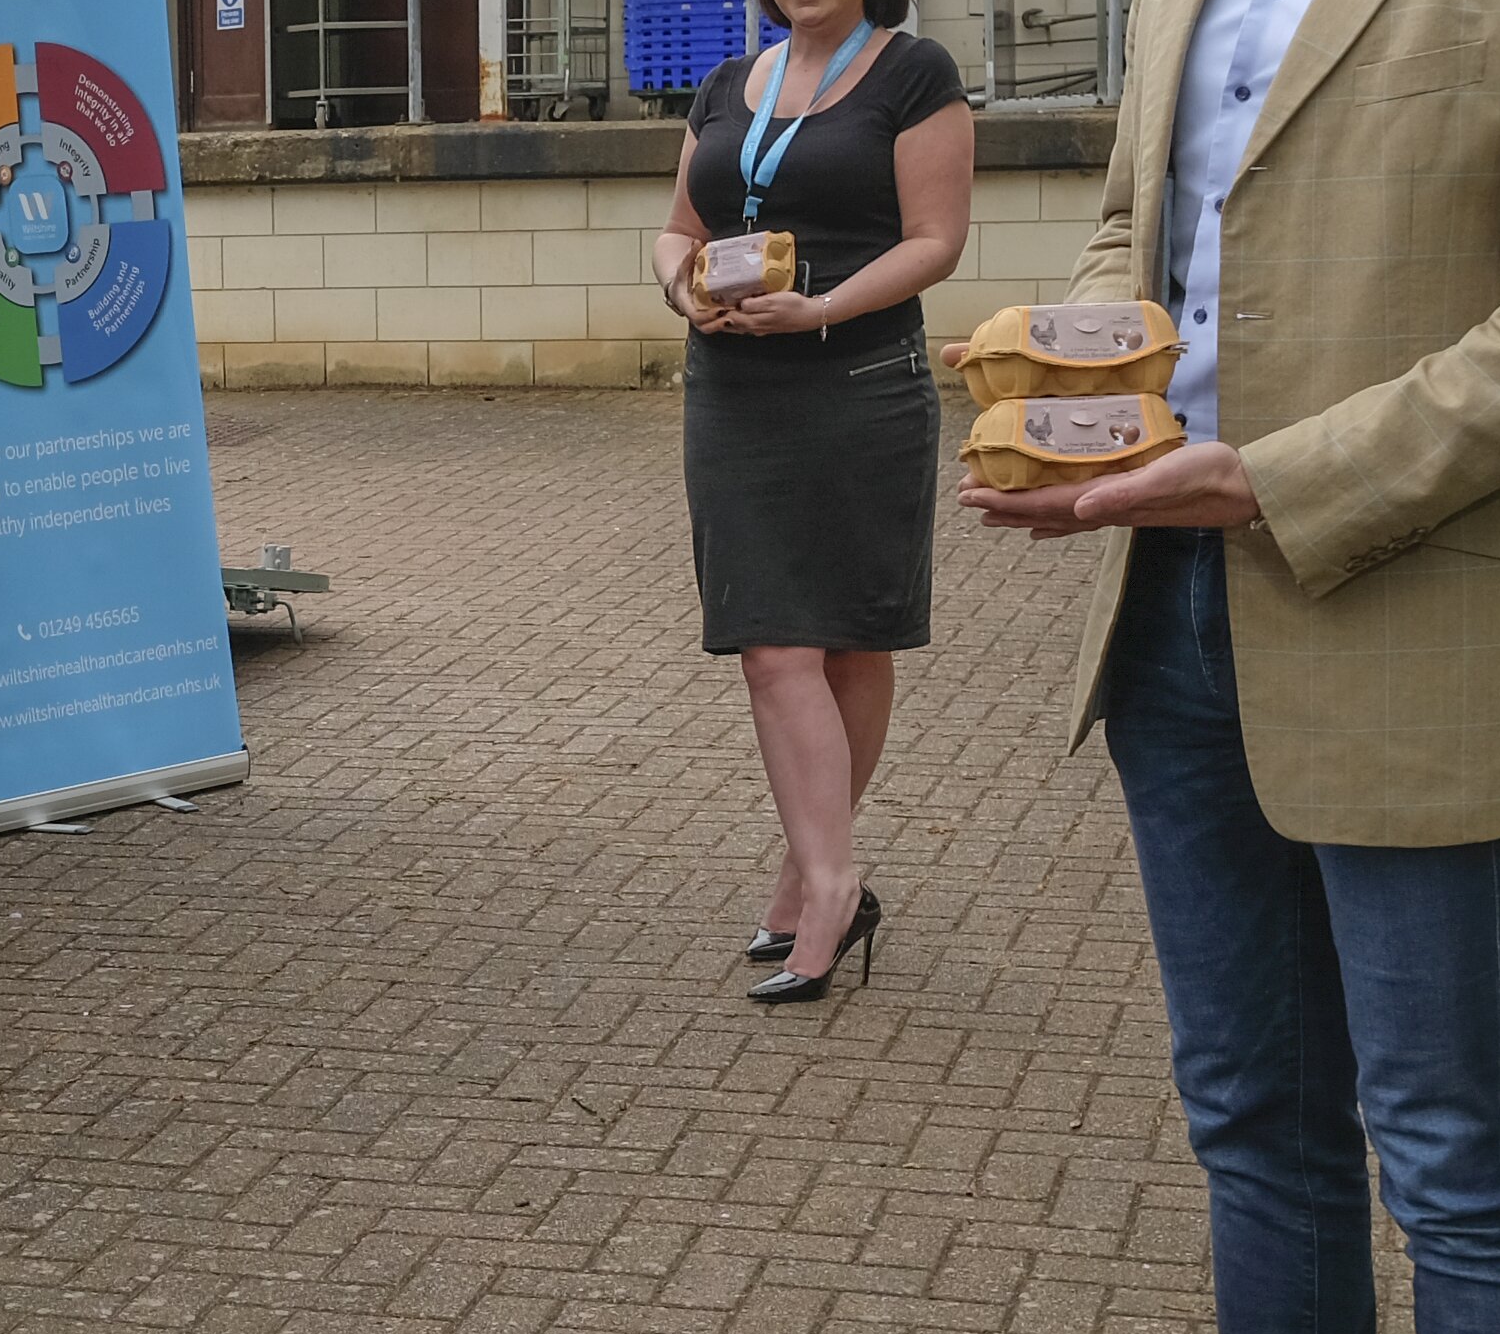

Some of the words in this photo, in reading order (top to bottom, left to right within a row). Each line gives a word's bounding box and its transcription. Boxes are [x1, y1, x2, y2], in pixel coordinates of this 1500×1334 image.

[74, 85, 112, 119] Integrity
[110, 119, 119, 132] in
[117, 131, 131, 146] all
[76, 101, 94, 120] that
[94, 117, 106, 132] we
[106, 133, 116, 147] do
[78, 74, 134, 137] Demonstrating
[59, 139, 91, 177] Integrity
[65, 238, 101, 288] Partnership
[87, 284, 120, 320] Building
[116, 261, 128, 283] and
[92, 266, 140, 331] Strengthening
[104, 280, 145, 337] Partnerships
[5, 442, 30, 460] our
[35, 429, 134, 459] partnerships
[139, 427, 163, 443] we
[169, 422, 191, 439] are
[5, 480, 20, 498] to
[24, 474, 77, 496] enable
[81, 465, 139, 492] people
[144, 461, 160, 478] to
[164, 457, 191, 476] live
[30, 503, 130, 532] independent
[135, 496, 171, 516] lives
[38, 616, 82, 640] 01249
[85, 605, 140, 630] 456565
